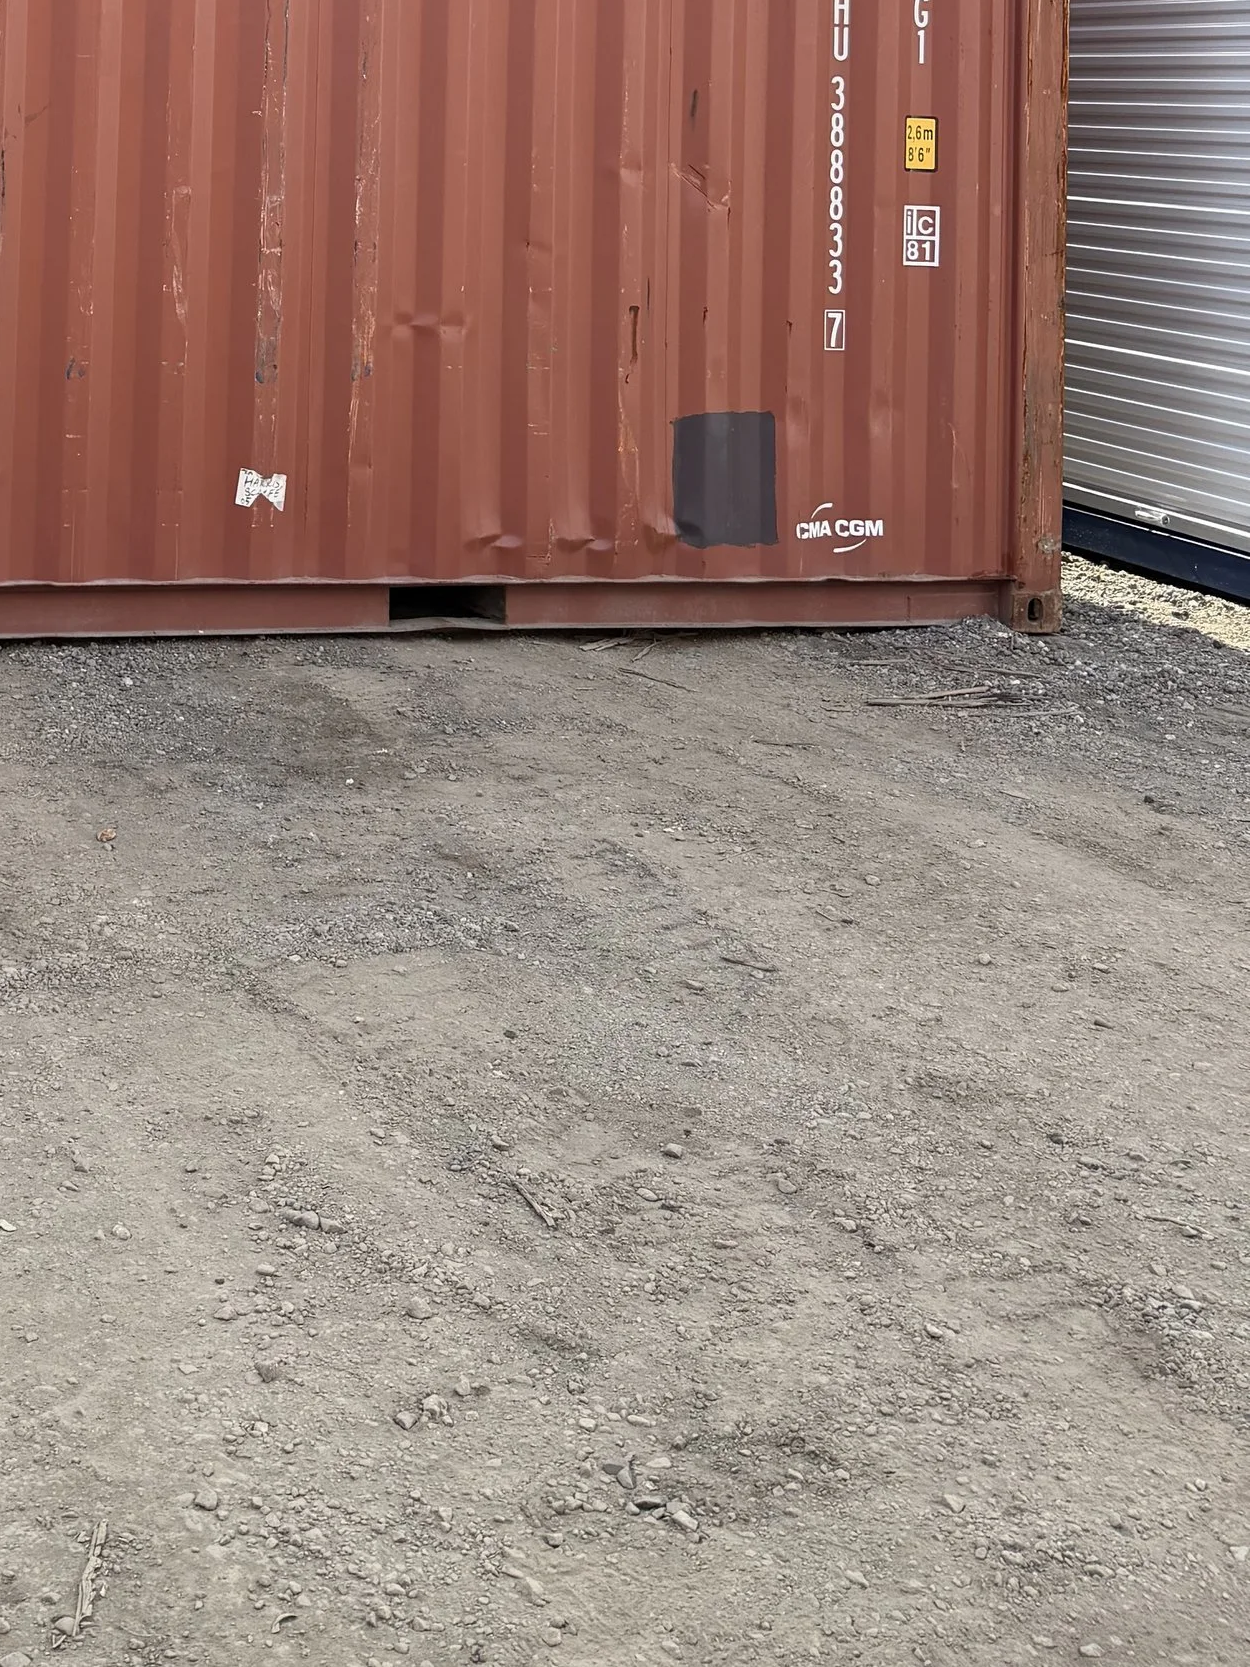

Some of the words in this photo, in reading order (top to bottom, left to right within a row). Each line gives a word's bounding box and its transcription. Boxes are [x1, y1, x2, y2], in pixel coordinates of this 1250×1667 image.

[828, 75, 845, 295] 388833
[906, 240, 932, 261] 81
[827, 313, 842, 348] 7
[796, 520, 832, 540] CMA
[834, 519, 884, 537] CGM
